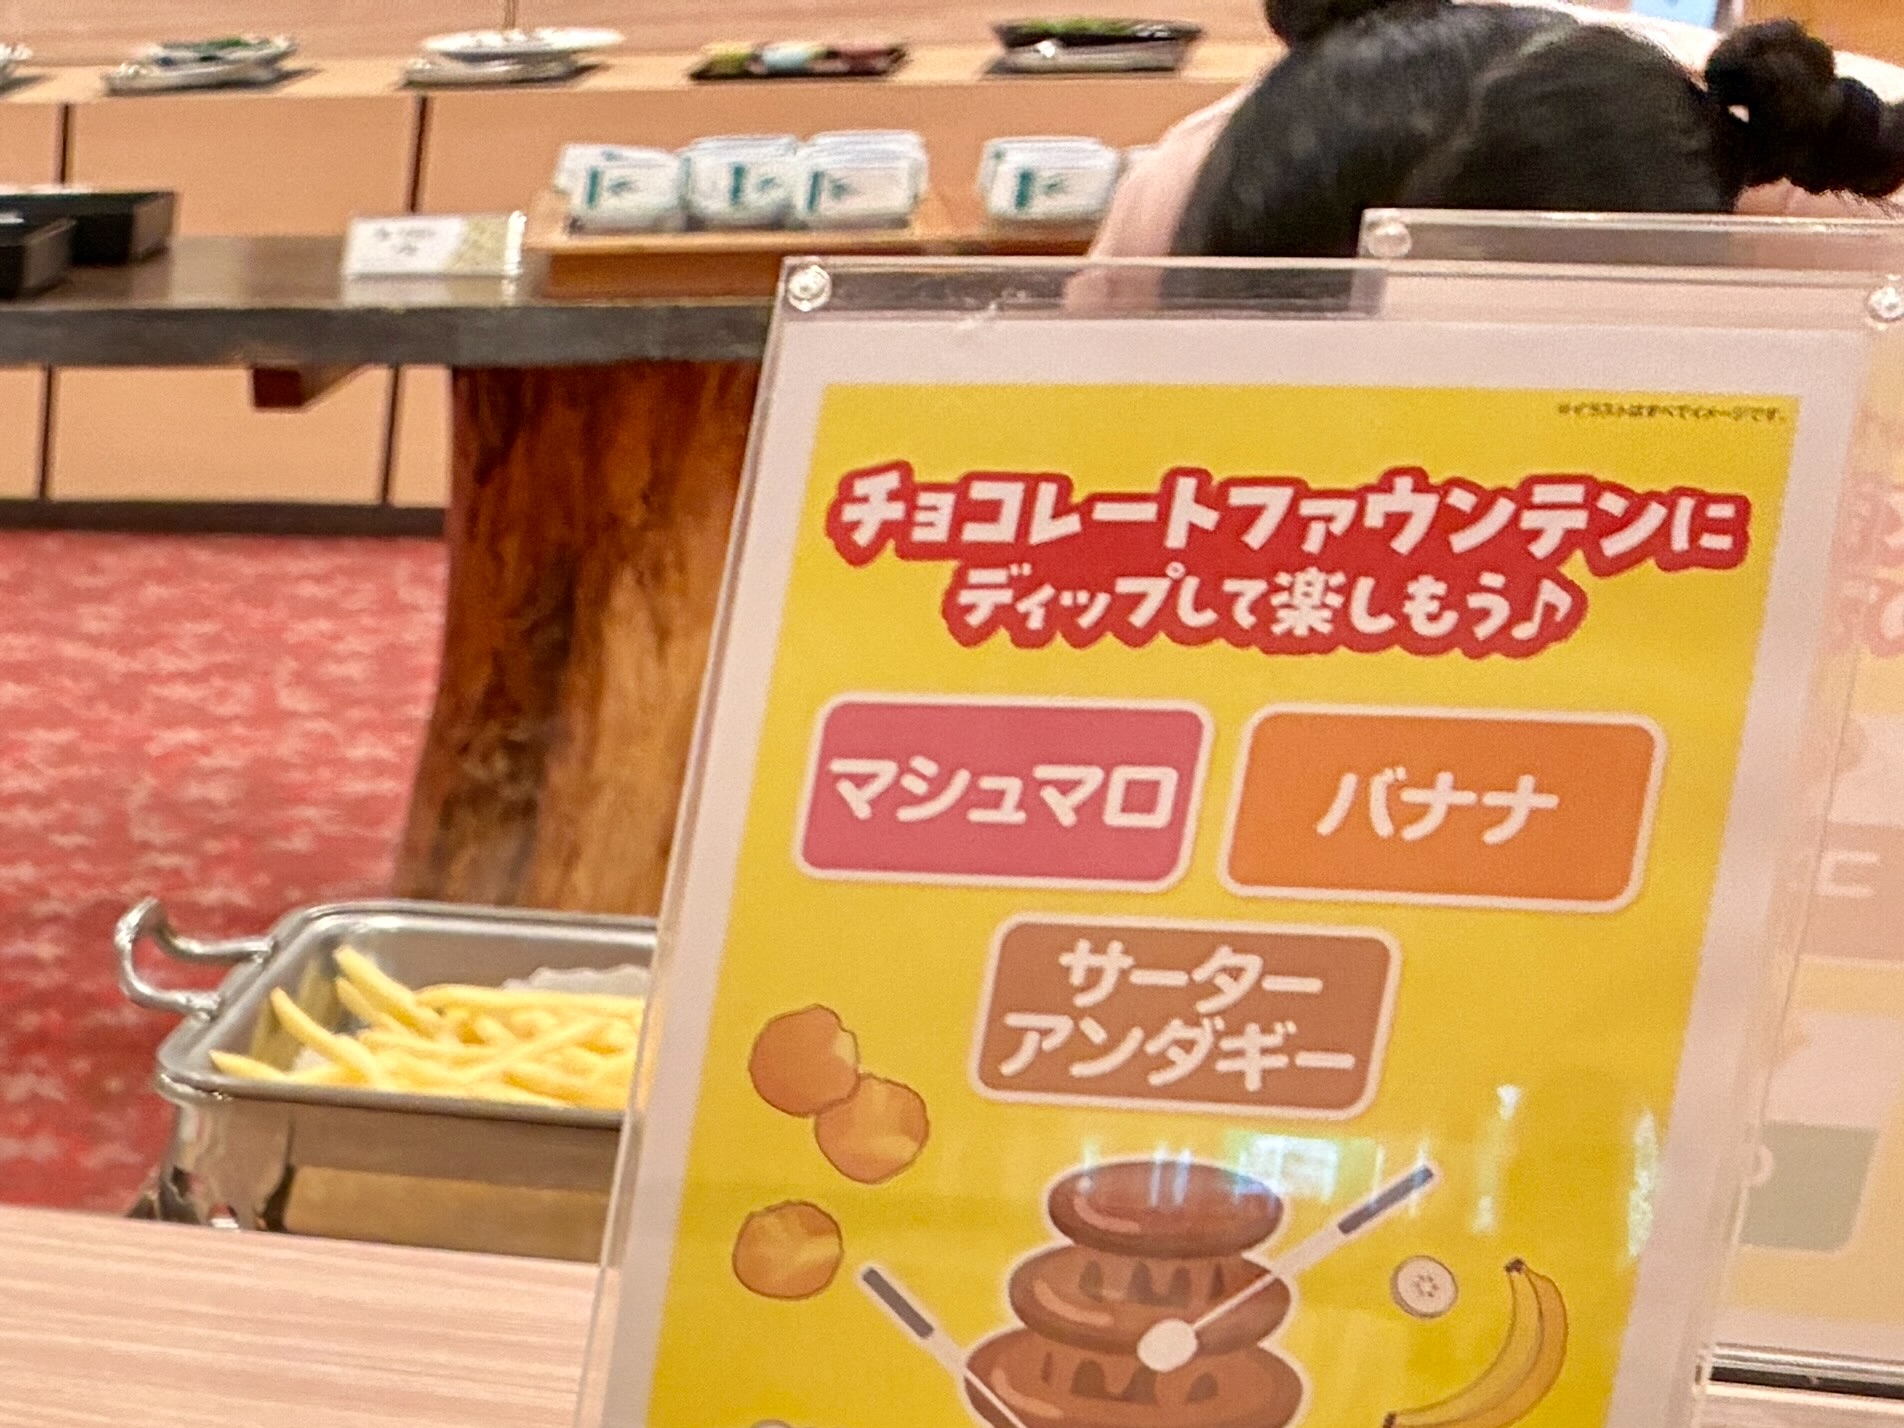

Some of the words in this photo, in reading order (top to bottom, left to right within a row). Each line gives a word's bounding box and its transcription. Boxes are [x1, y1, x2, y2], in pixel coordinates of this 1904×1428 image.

[840, 470, 1735, 560] チョコレートファウンテンに
[829, 754, 1180, 829] マシュマロ
[1315, 765, 1560, 845] バナナ
[1058, 938, 1323, 1015] サーター
[998, 1010, 1356, 1093] アンダギー
